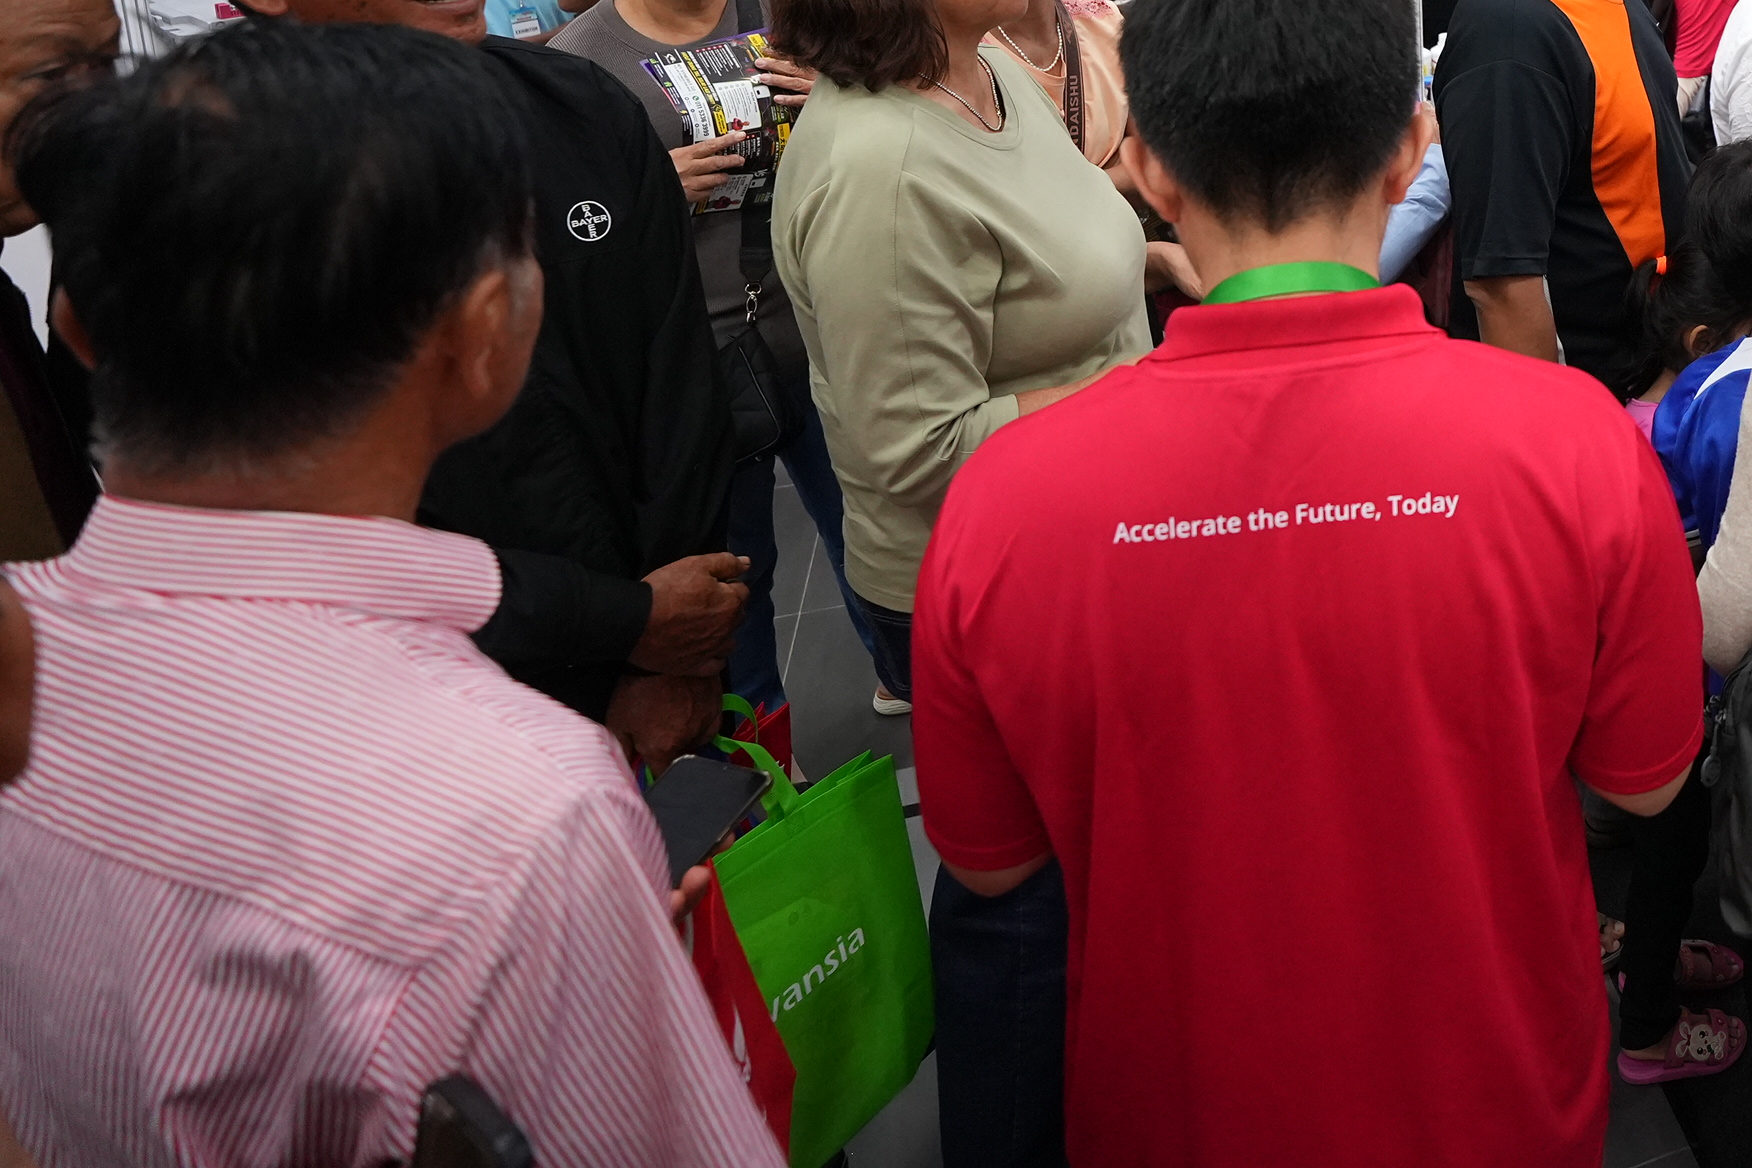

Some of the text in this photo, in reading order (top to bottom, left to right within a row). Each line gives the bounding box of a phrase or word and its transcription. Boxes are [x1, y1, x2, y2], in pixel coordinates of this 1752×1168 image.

[571, 214, 608, 228] BAYER
[1112, 491, 1460, 545] Accelerate the Future, Today
